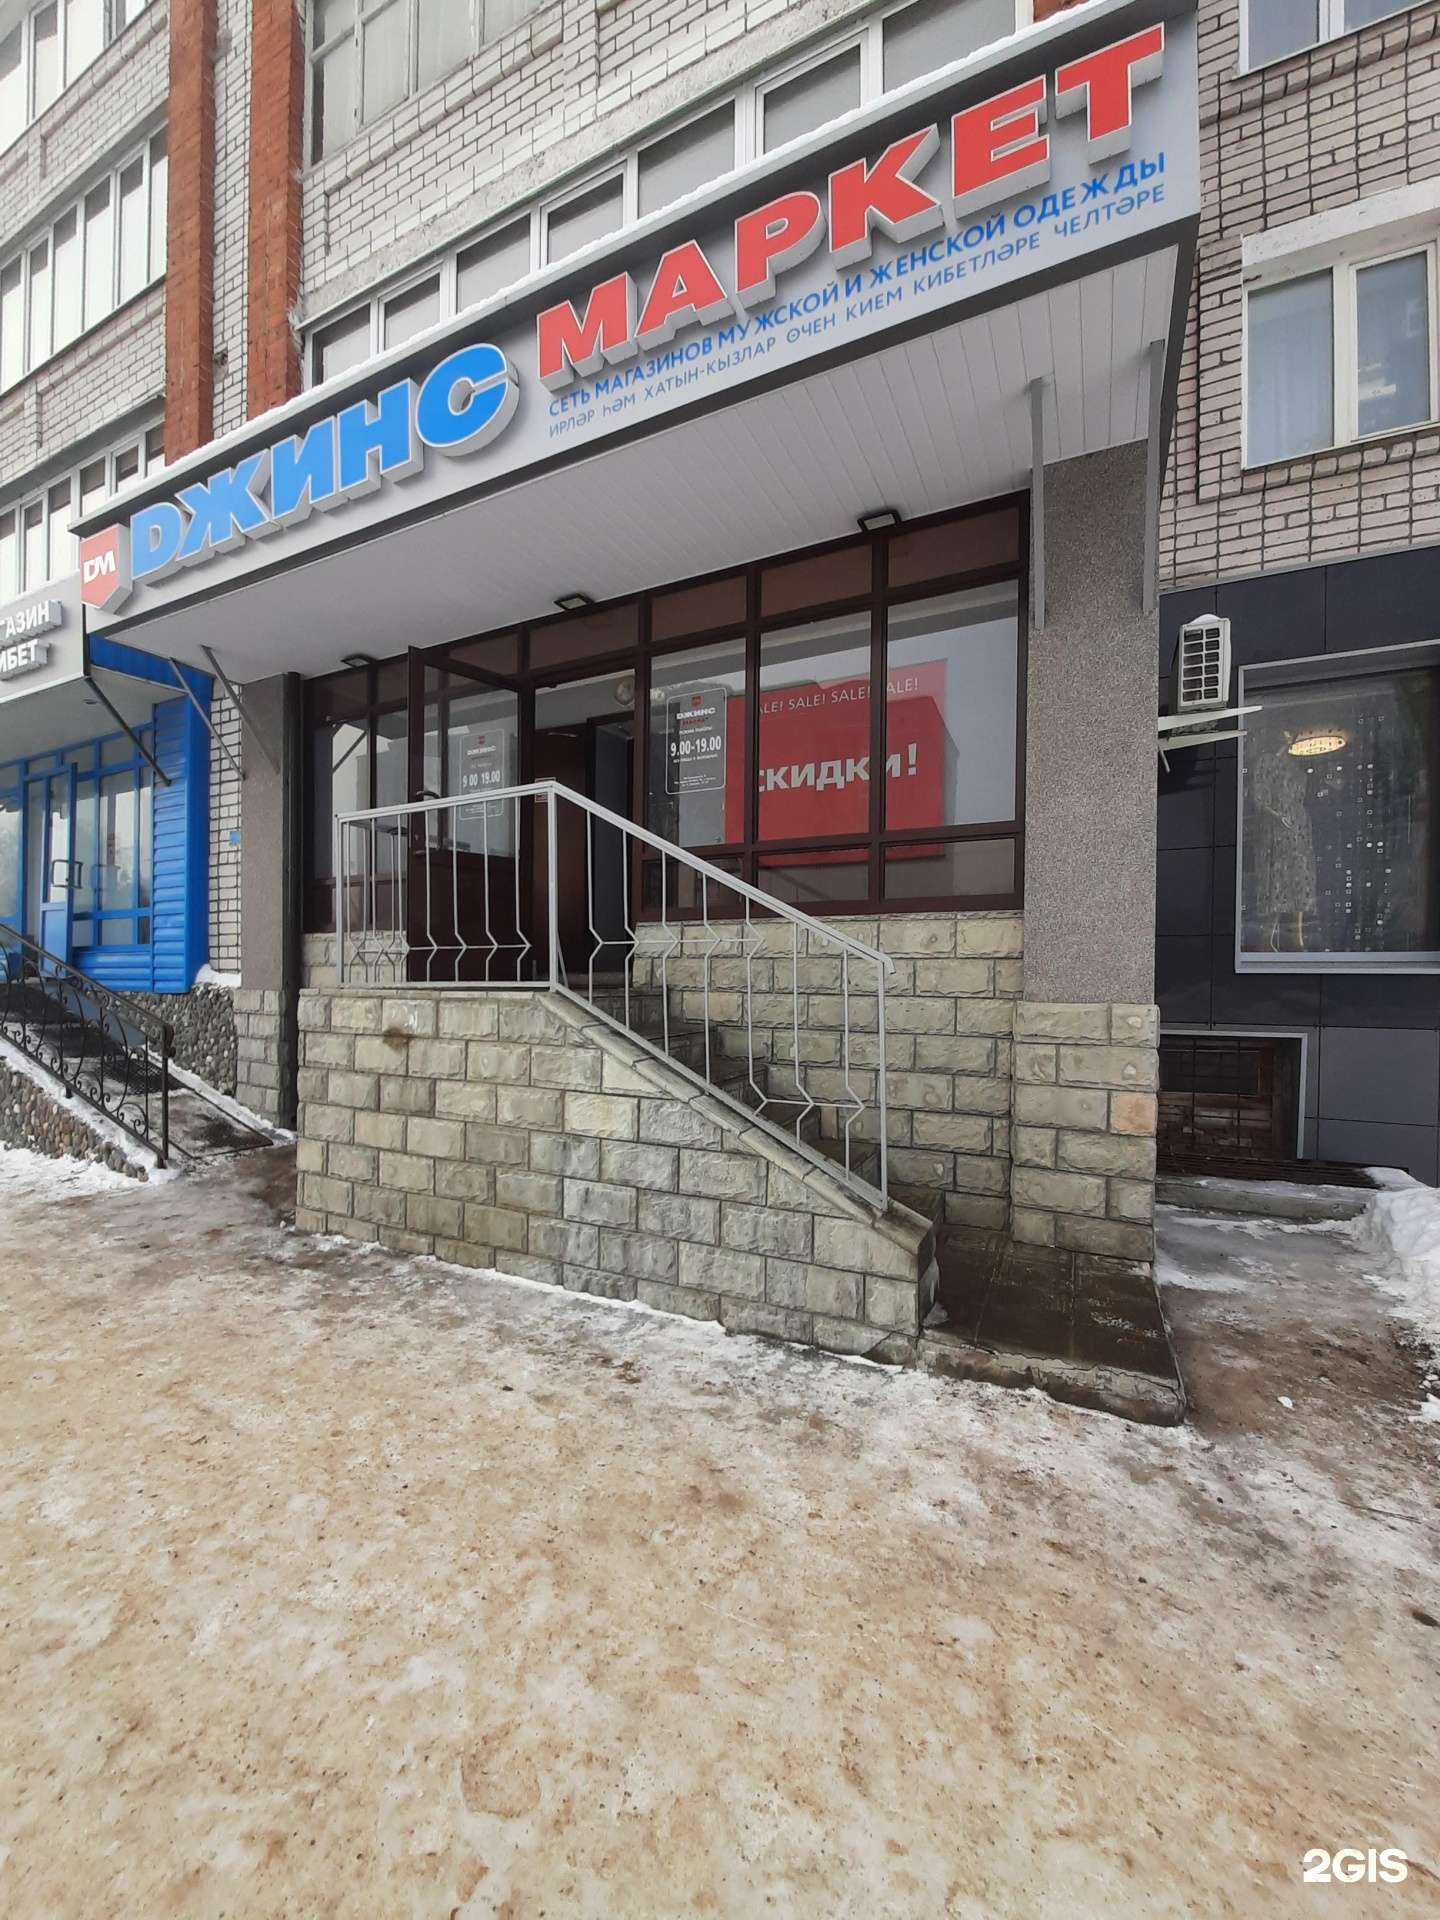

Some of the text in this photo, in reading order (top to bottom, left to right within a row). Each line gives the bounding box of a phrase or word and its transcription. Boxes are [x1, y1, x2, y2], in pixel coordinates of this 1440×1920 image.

[537, 21, 1166, 381] МАРКЕТ
[549, 152, 1165, 417] СЕТЬ МАГАЗИНОВ МУЖСКОЙ И ЖЕНСКОЙ ОДЕЖДЫ
[549, 408, 595, 438] ИРЛӘР
[643, 336, 776, 401] ХАТЫН-КЫЗЛАР
[786, 313, 836, 344] ӨЧЕН
[845, 286, 902, 322] КИЕМ
[913, 232, 1040, 295] КИБЕТЛӘРЕ
[1053, 184, 1165, 237] ЧЕЛТӘРЕ
[670, 735, 722, 757] 9.00-19.00
[758, 742, 918, 793] КИДКИ!
[788, 695, 826, 711] SALE!
[831, 686, 871, 704] SALE!
[886, 677, 919, 695] ALE!
